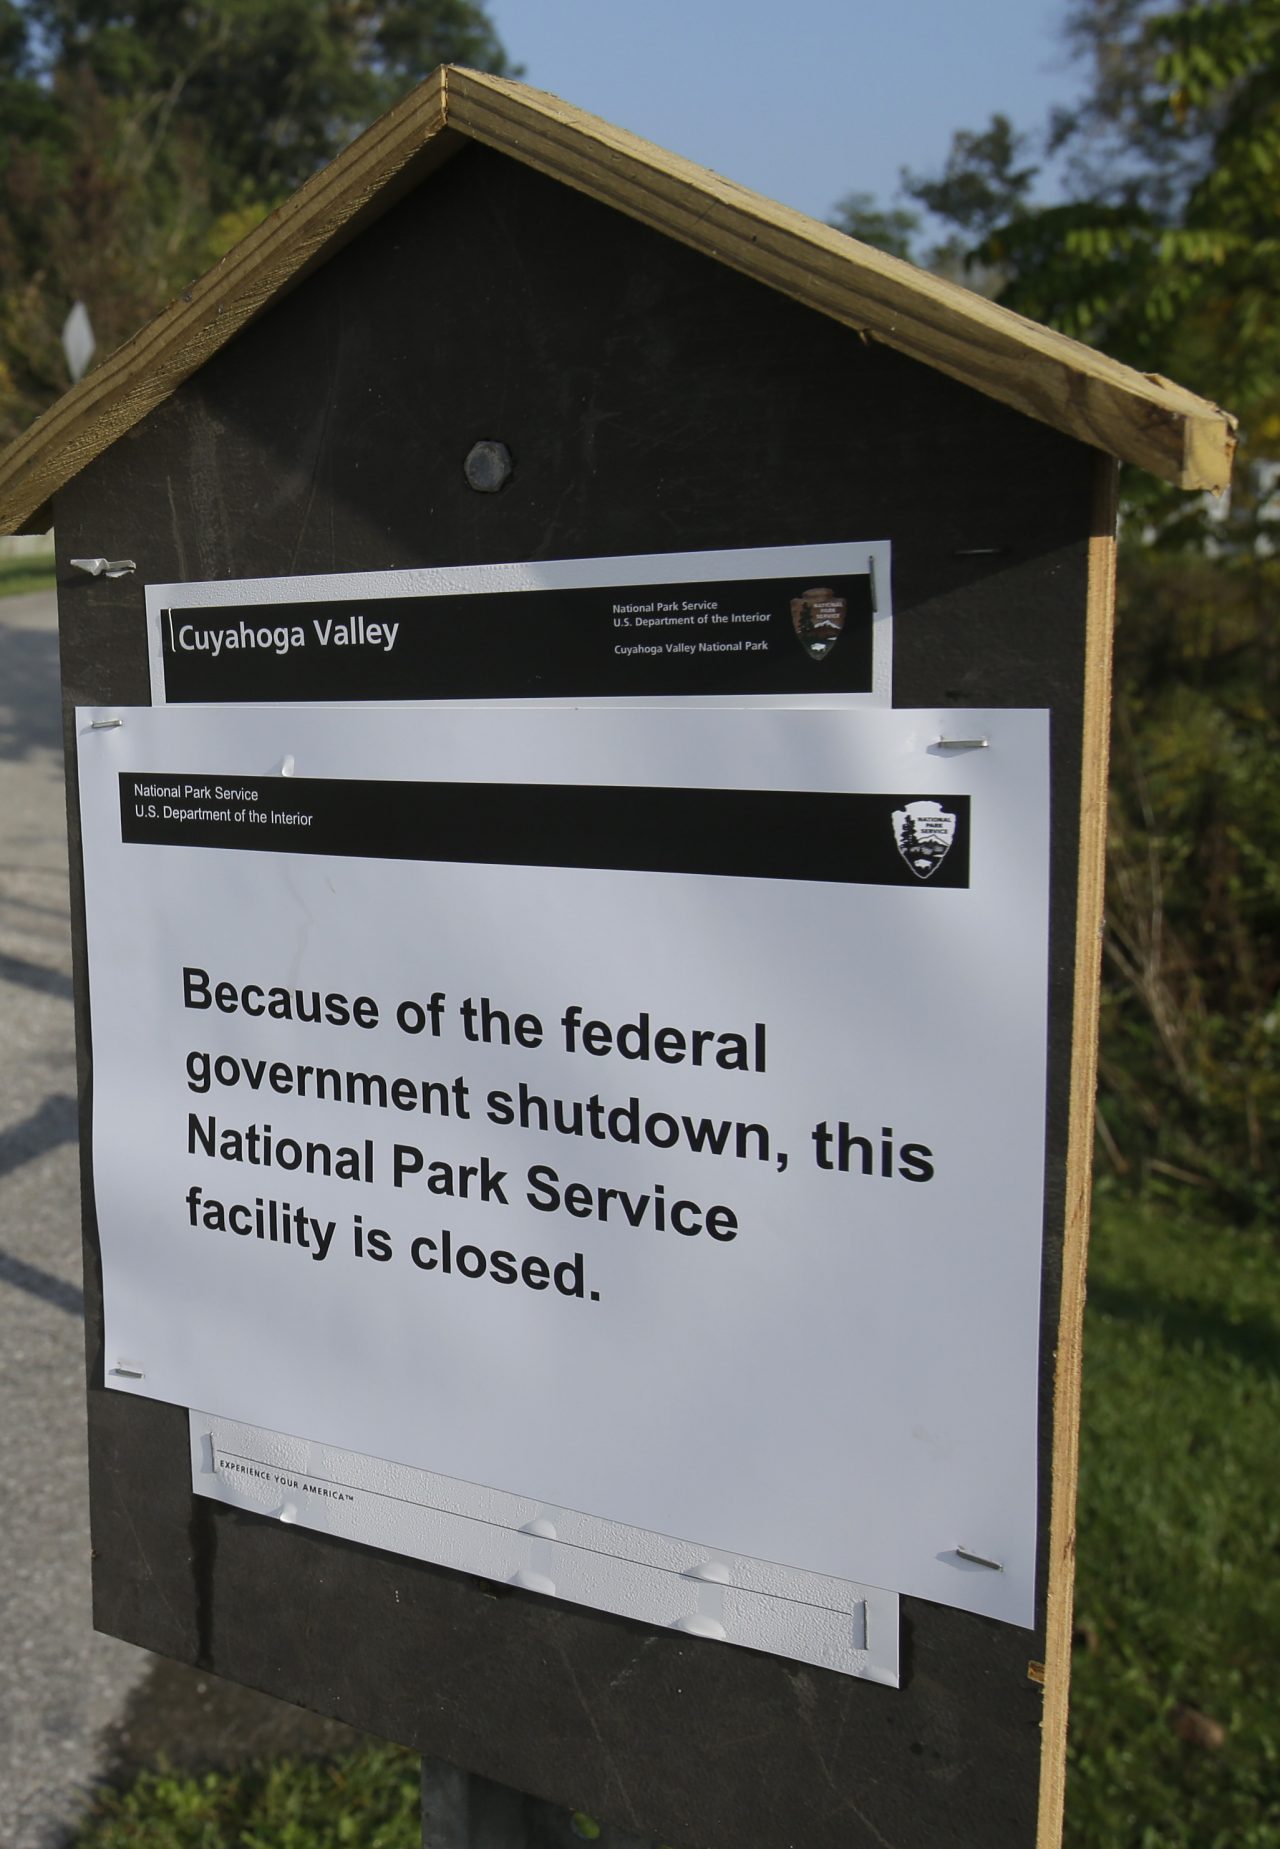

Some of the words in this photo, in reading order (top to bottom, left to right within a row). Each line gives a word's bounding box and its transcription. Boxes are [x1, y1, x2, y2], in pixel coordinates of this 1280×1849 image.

[613, 602, 654, 613] National
[657, 601, 679, 612] Park
[682, 600, 718, 610] Service
[613, 617, 632, 627] U.S.
[635, 615, 694, 628] Department
[697, 613, 708, 624] of
[711, 613, 729, 623] the
[732, 612, 771, 622] Interior
[179, 621, 305, 656] Cuyahoga
[313, 616, 400, 651] Valley
[614, 644, 663, 656] Cuyahoga
[666, 643, 696, 655] Valley
[699, 641, 742, 652] National
[745, 640, 768, 650] Park
[134, 783, 181, 798] National
[185, 785, 211, 799] Park
[215, 786, 259, 801] Service
[135, 804, 159, 818] U.S.
[163, 805, 231, 822] Department
[234, 809, 246, 822] of
[249, 810, 267, 824] the
[271, 811, 313, 826] Interior
[182, 966, 379, 1029] Because
[396, 992, 446, 1037] of
[460, 997, 544, 1049] the
[561, 1005, 766, 1073] federal
[186, 1050, 470, 1120] government
[486, 1083, 788, 1173] shutdown,
[811, 1120, 934, 1183] this
[188, 1112, 374, 1183] National
[393, 1143, 509, 1205] Park
[526, 1164, 738, 1243] Service
[186, 1186, 336, 1261] facility
[353, 1215, 393, 1262] is
[411, 1229, 600, 1302] closed.
[220, 1460, 270, 1480] EXPERIENCE
[274, 1475, 299, 1489] YOUR
